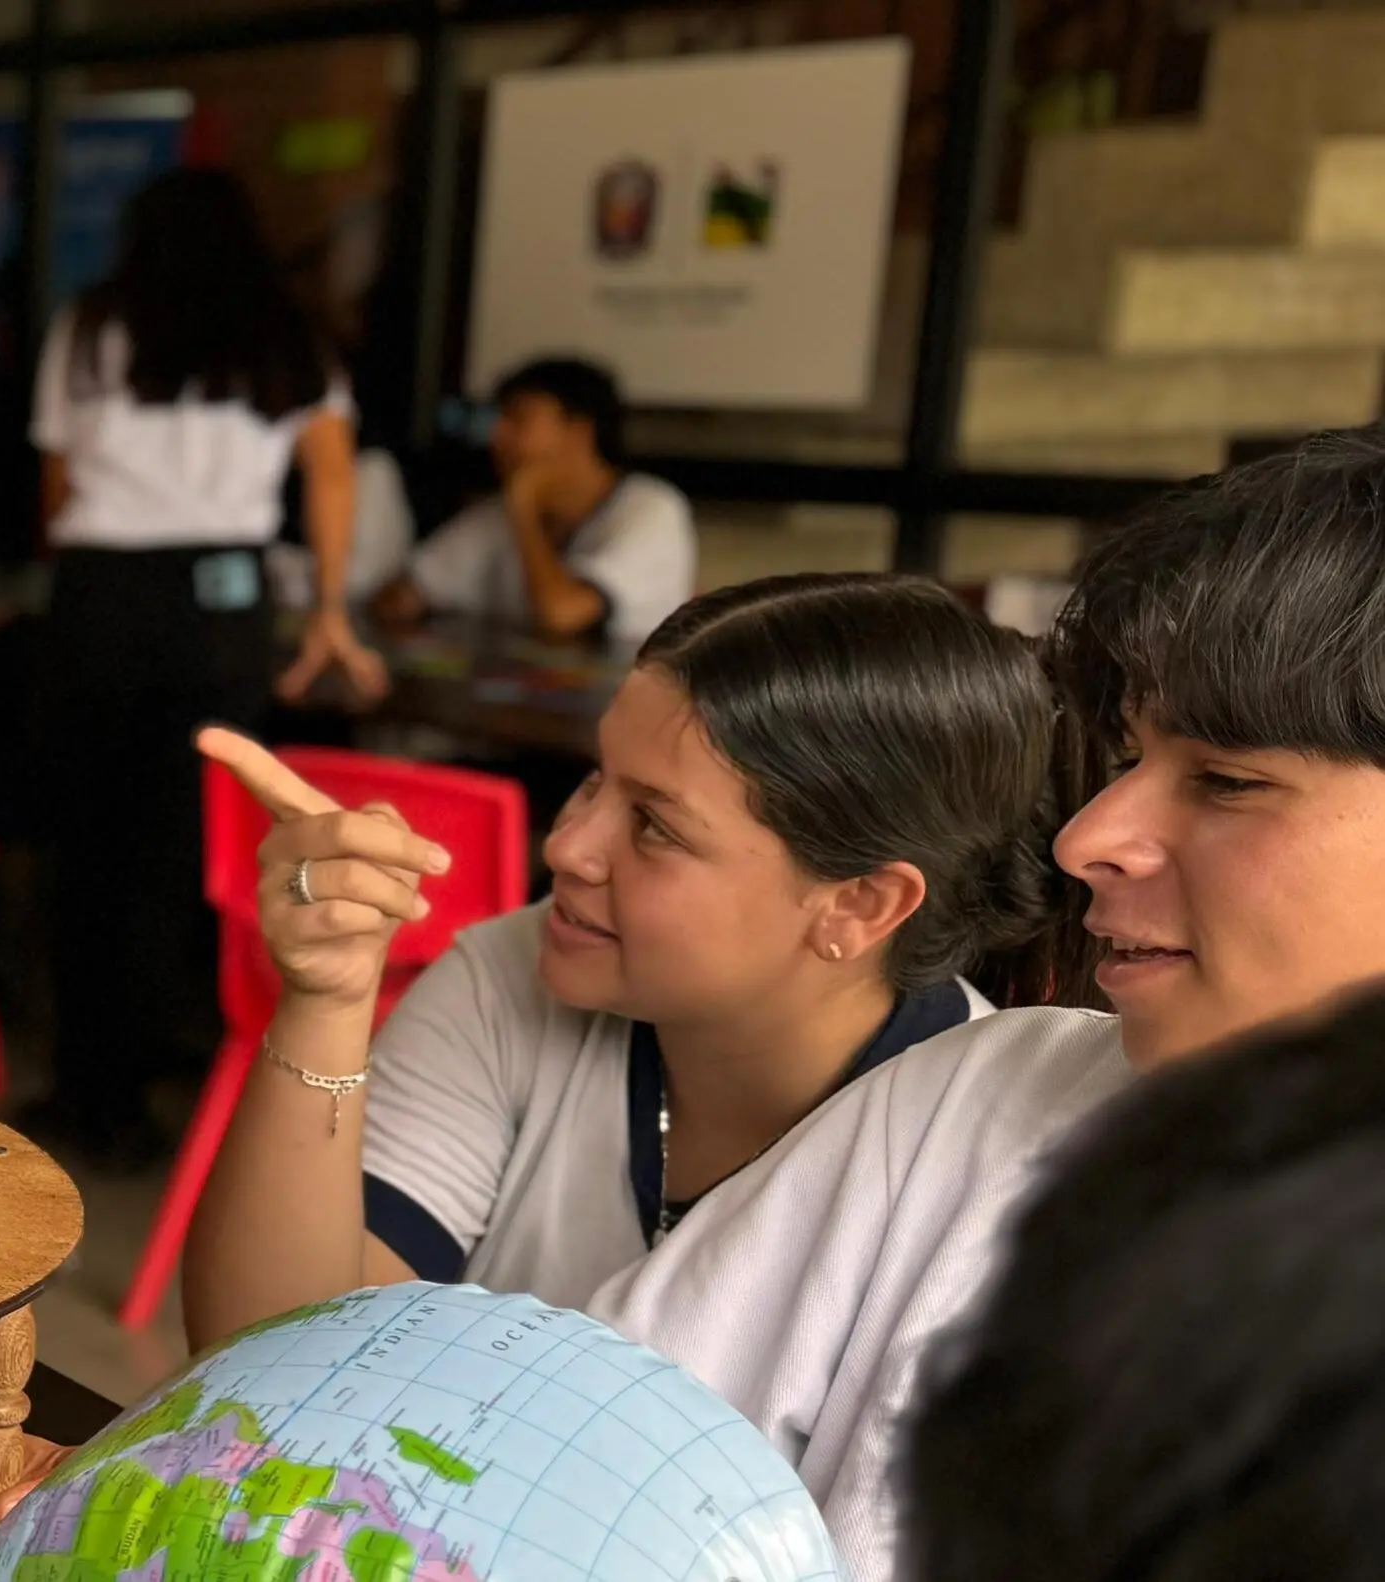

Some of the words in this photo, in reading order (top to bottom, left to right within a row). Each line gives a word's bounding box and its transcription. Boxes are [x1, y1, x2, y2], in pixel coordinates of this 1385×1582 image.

[355, 1304, 437, 1370] INDIAN
[491, 1308, 565, 1352] OCEAN
[122, 1519, 142, 1555] SUDAN
